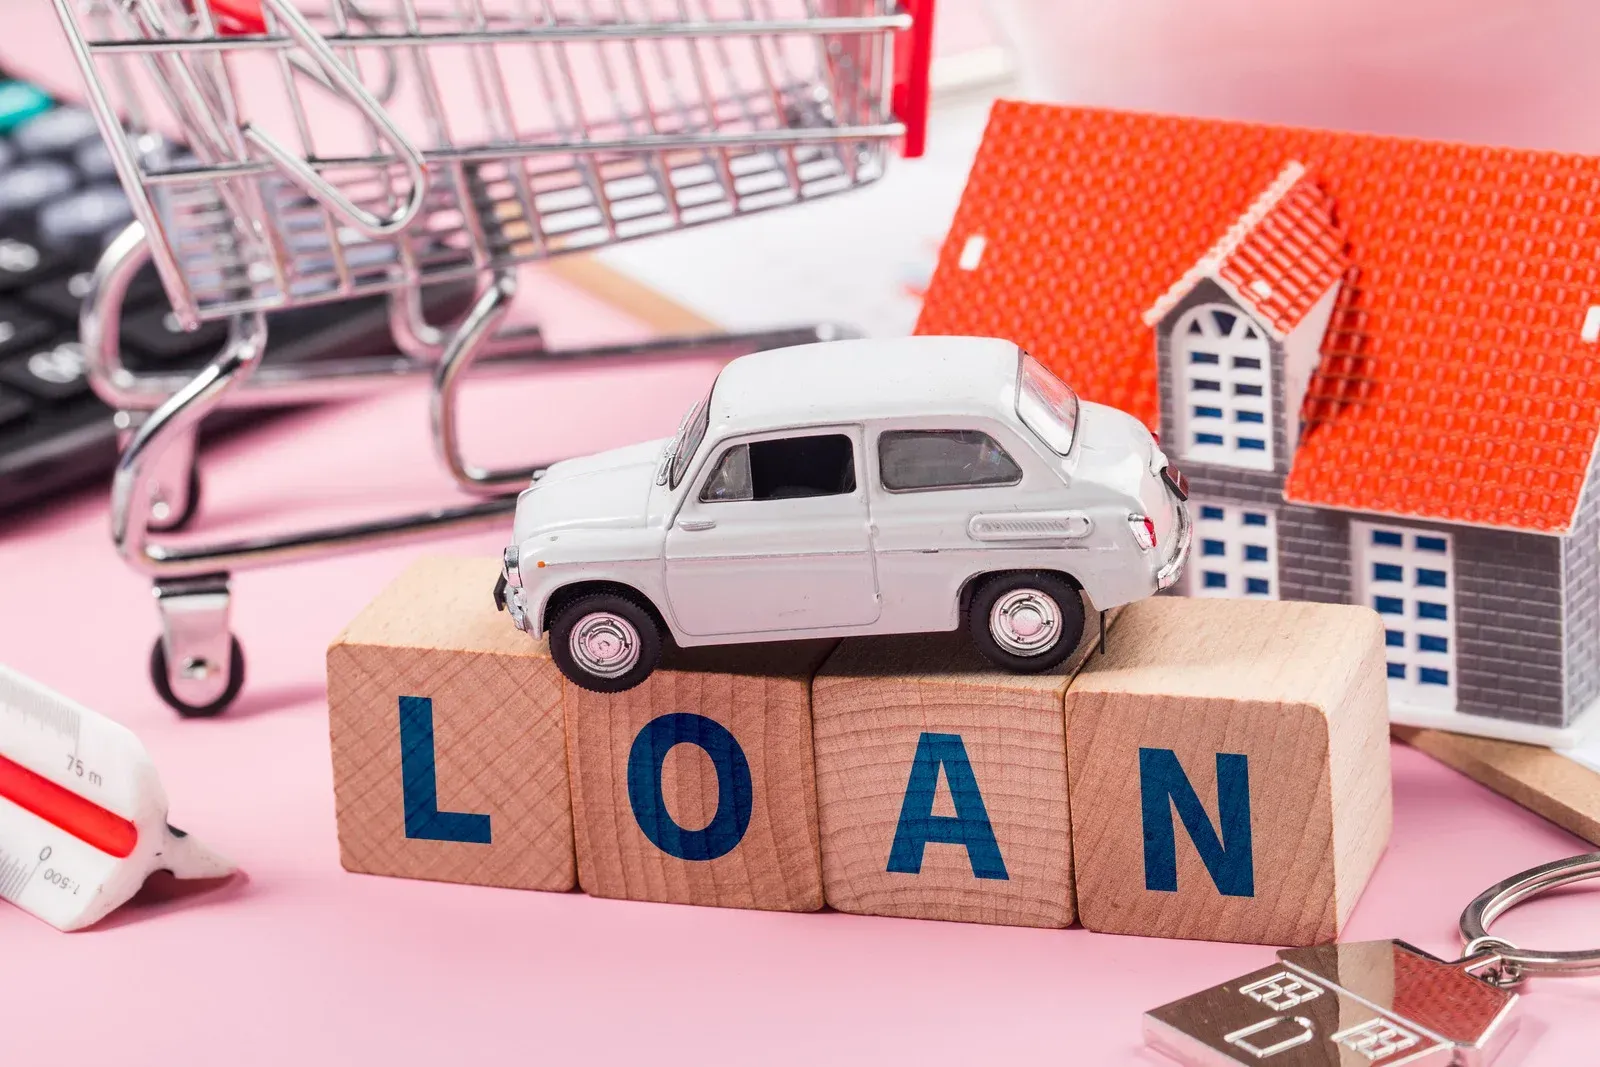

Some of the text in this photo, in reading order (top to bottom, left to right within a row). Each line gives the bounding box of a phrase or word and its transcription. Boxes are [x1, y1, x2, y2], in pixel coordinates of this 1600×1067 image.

[66, 755, 103, 787] 75 m
[398, 695, 1255, 898] LOAN
[44, 868, 80, 894] 1:500
